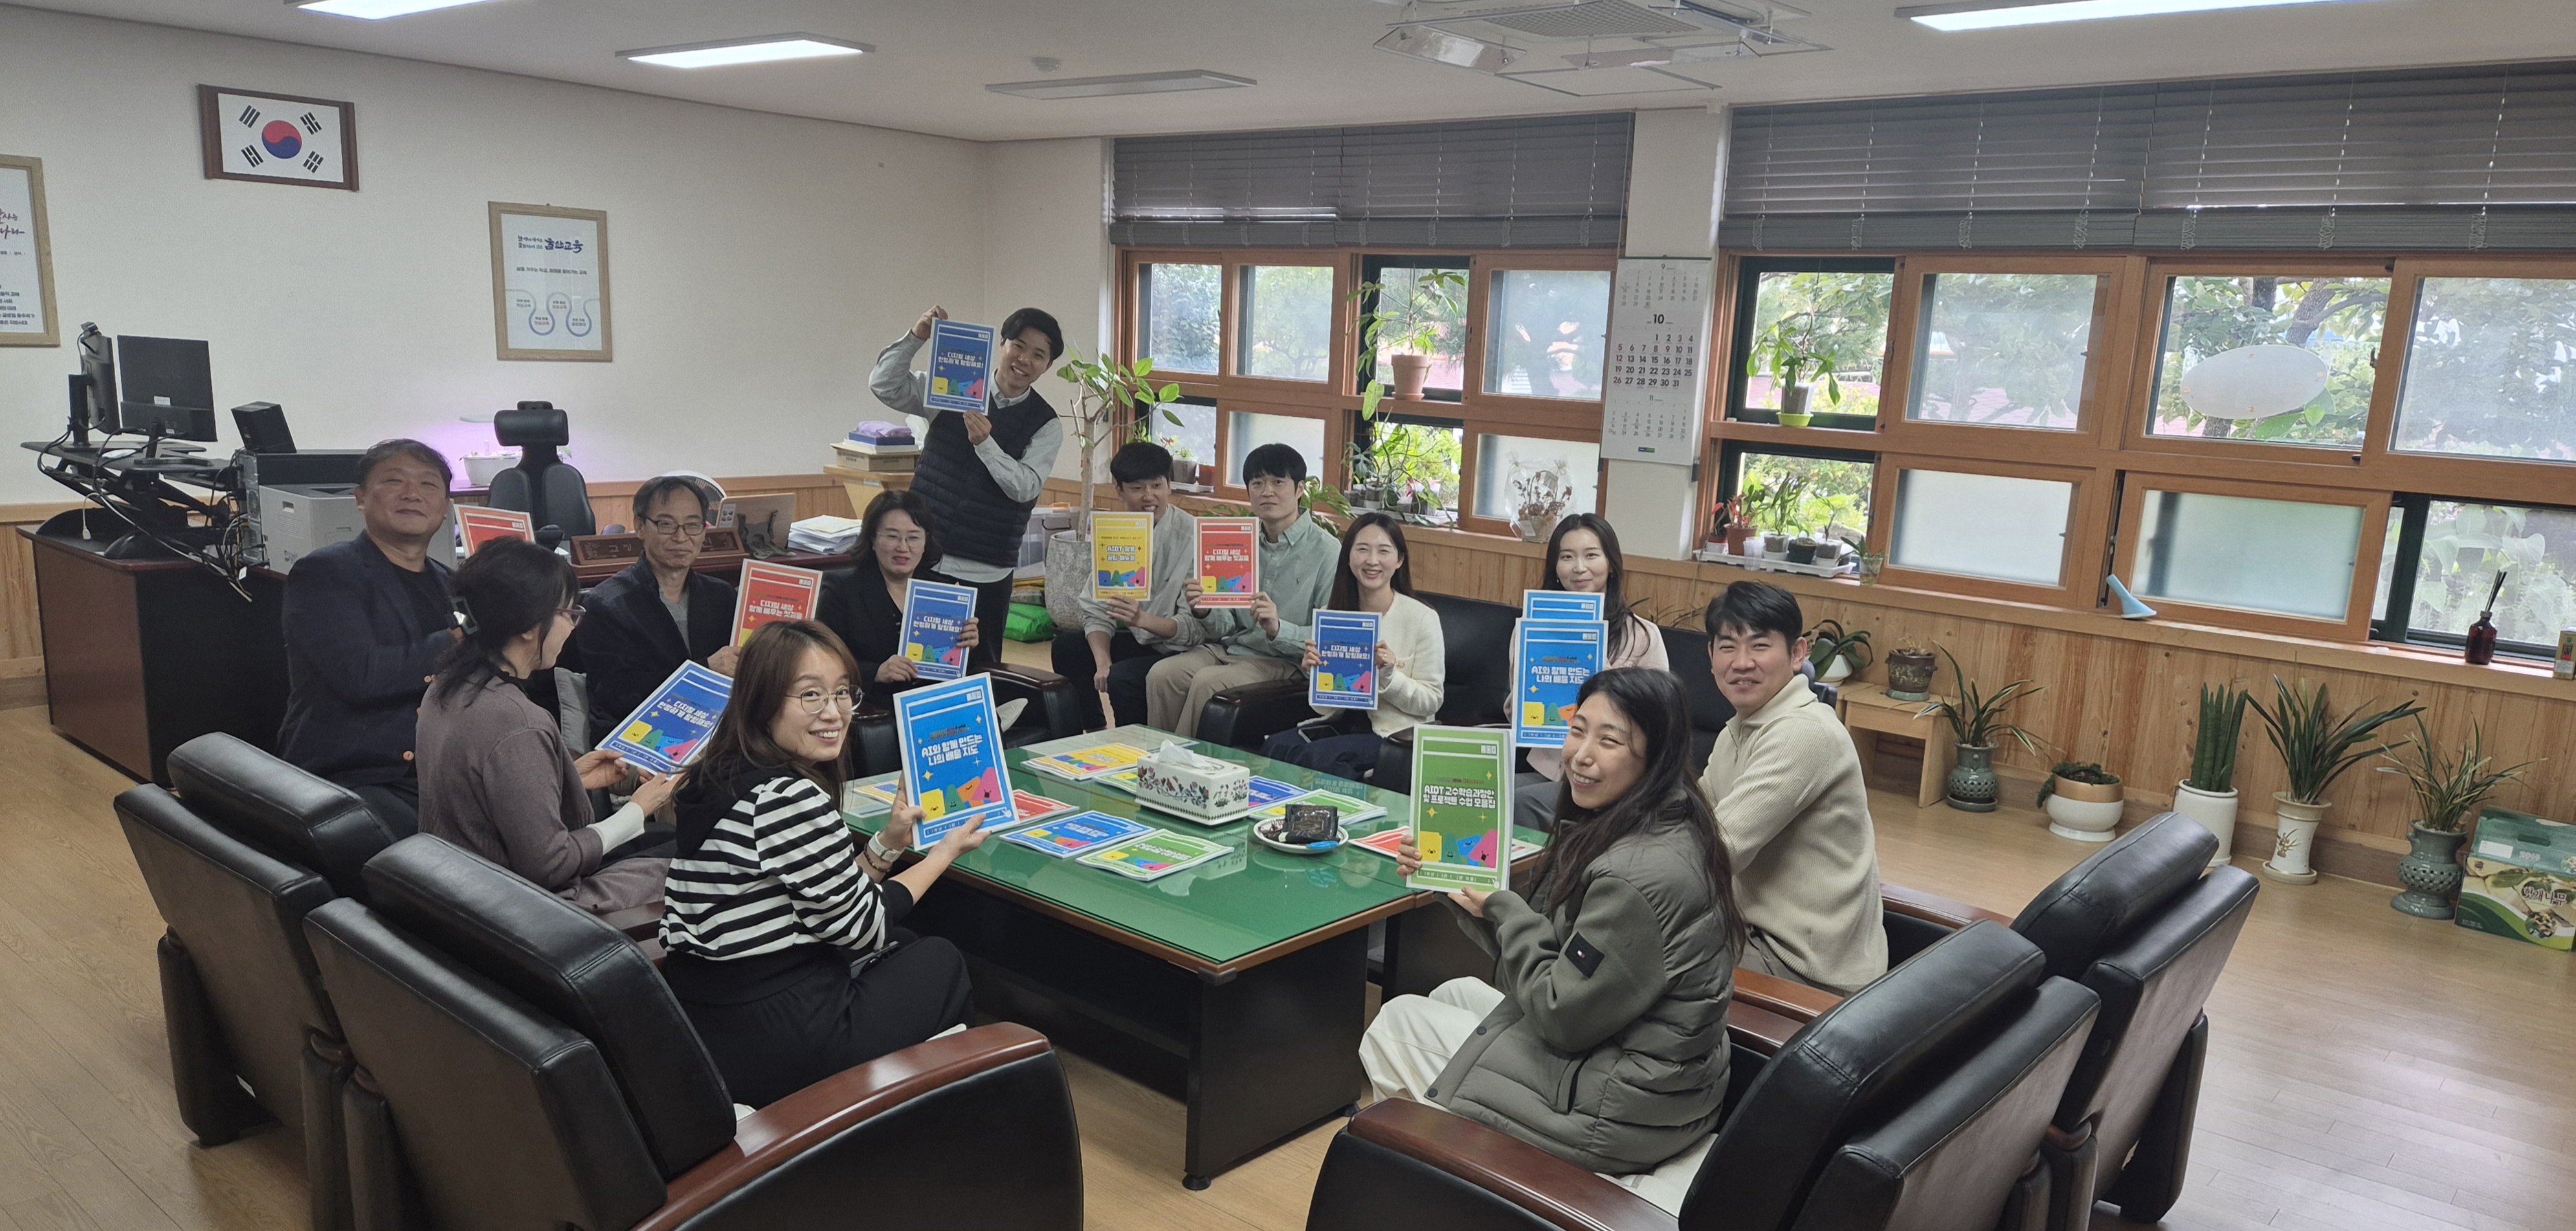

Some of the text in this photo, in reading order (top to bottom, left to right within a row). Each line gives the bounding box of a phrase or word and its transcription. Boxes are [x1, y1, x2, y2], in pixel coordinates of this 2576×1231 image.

[545, 238, 583, 253] 울산교육
[1654, 314, 1664, 324] 10
[760, 600, 780, 609] 디지털
[1551, 666, 1566, 675] 함께
[1568, 667, 1590, 676] 만드는
[1536, 675, 1585, 684] 나의 배움 지도
[922, 734, 982, 758] AI와 함께 만드는
[928, 744, 979, 766] 나의 배움 지도
[1424, 785, 1494, 799] AIDT 교수학습과정안
[1431, 795, 1457, 805] 프로젝트
[1459, 797, 1473, 807] 수업
[1474, 798, 1495, 808] 모음집
[2525, 887, 2567, 906] 헛개나무
